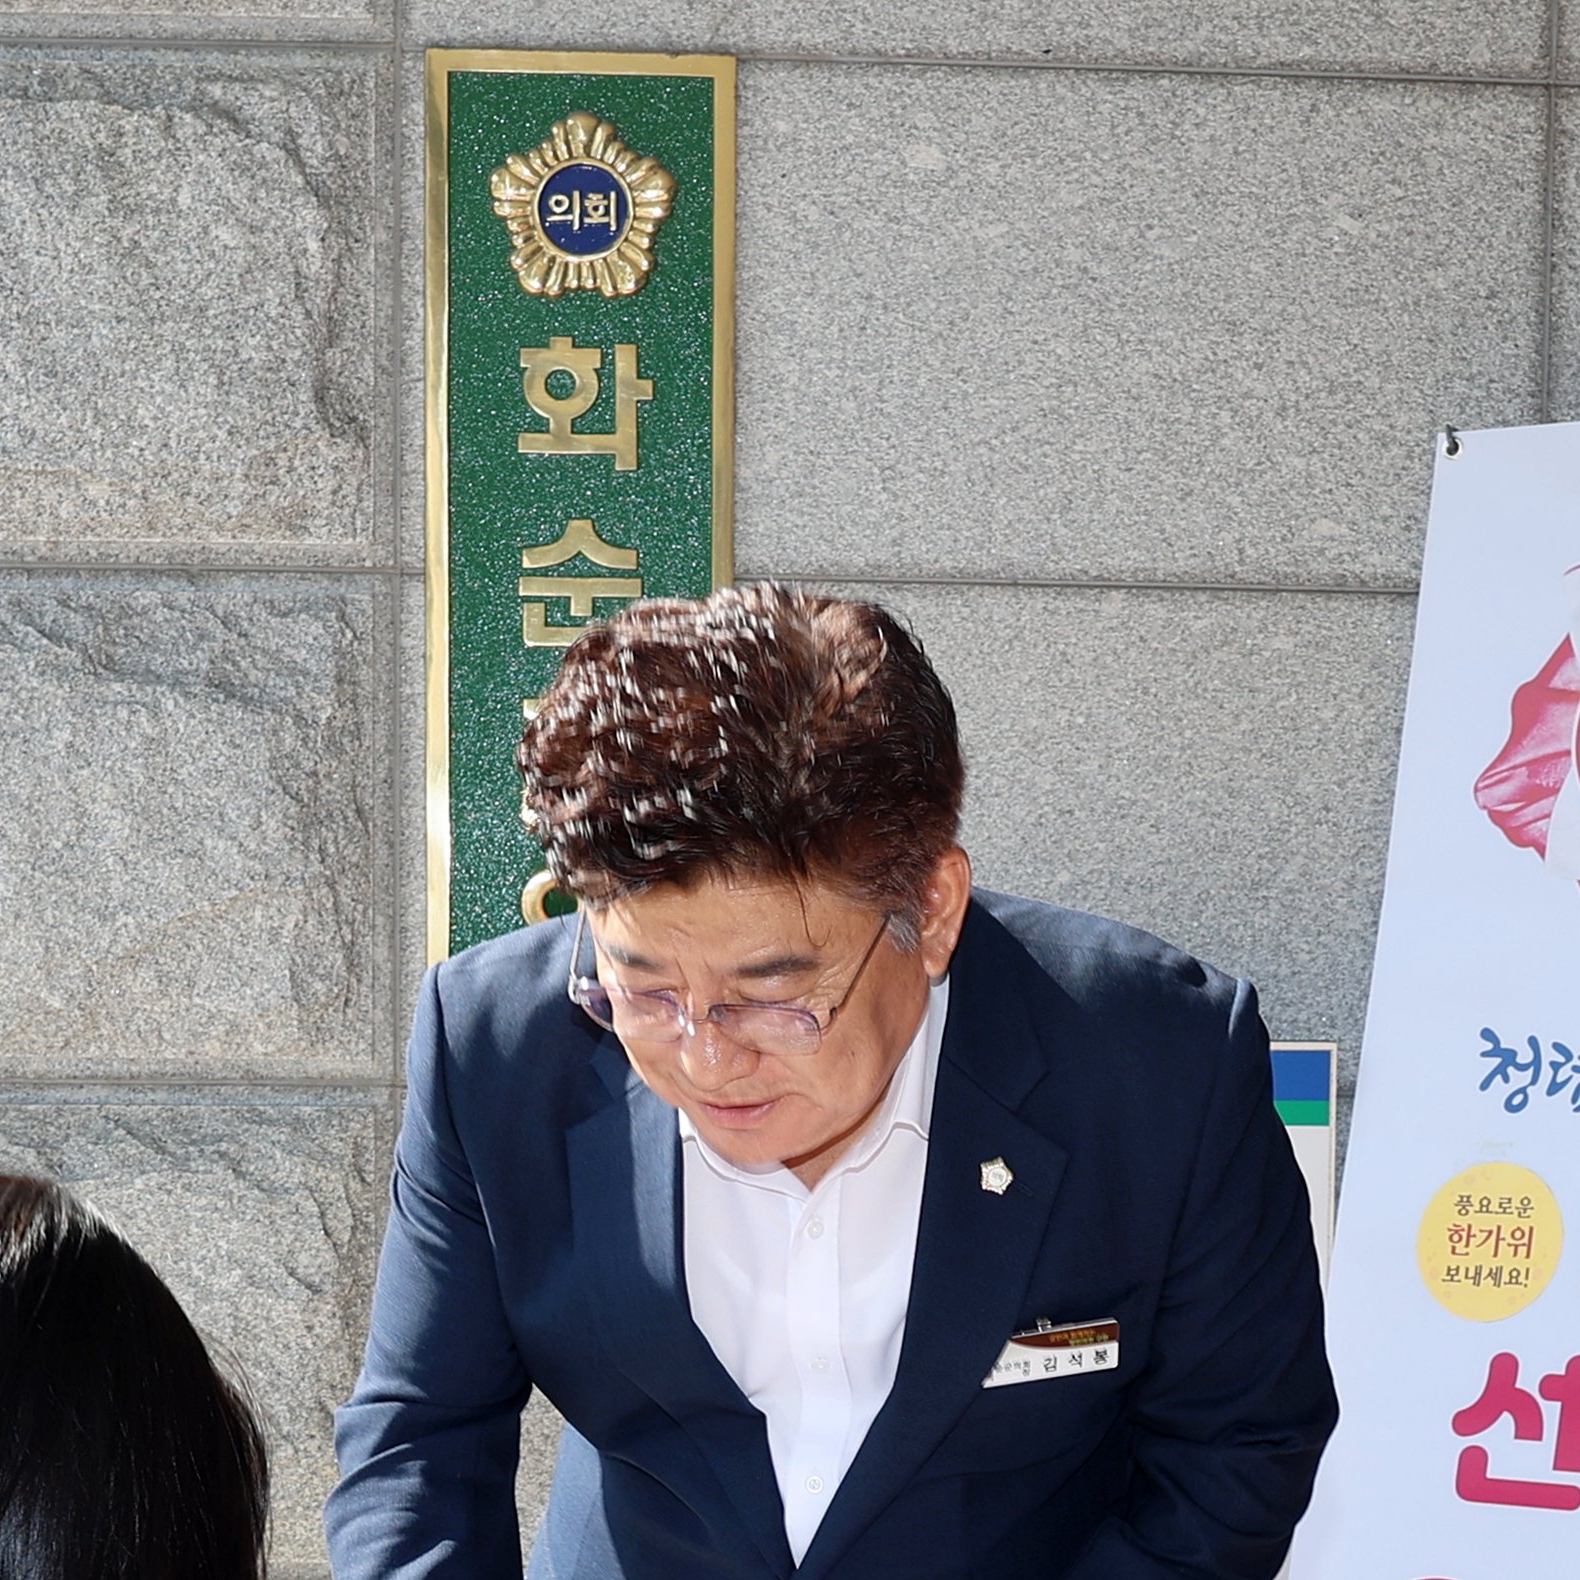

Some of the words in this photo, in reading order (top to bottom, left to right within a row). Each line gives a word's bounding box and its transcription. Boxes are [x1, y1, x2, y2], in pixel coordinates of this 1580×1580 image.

[546, 189, 617, 231] 의회
[1453, 1193, 1536, 1219] 풍요로운
[1446, 1221, 1535, 1260] 한가위
[1441, 1264, 1531, 1290] 보내세요!
